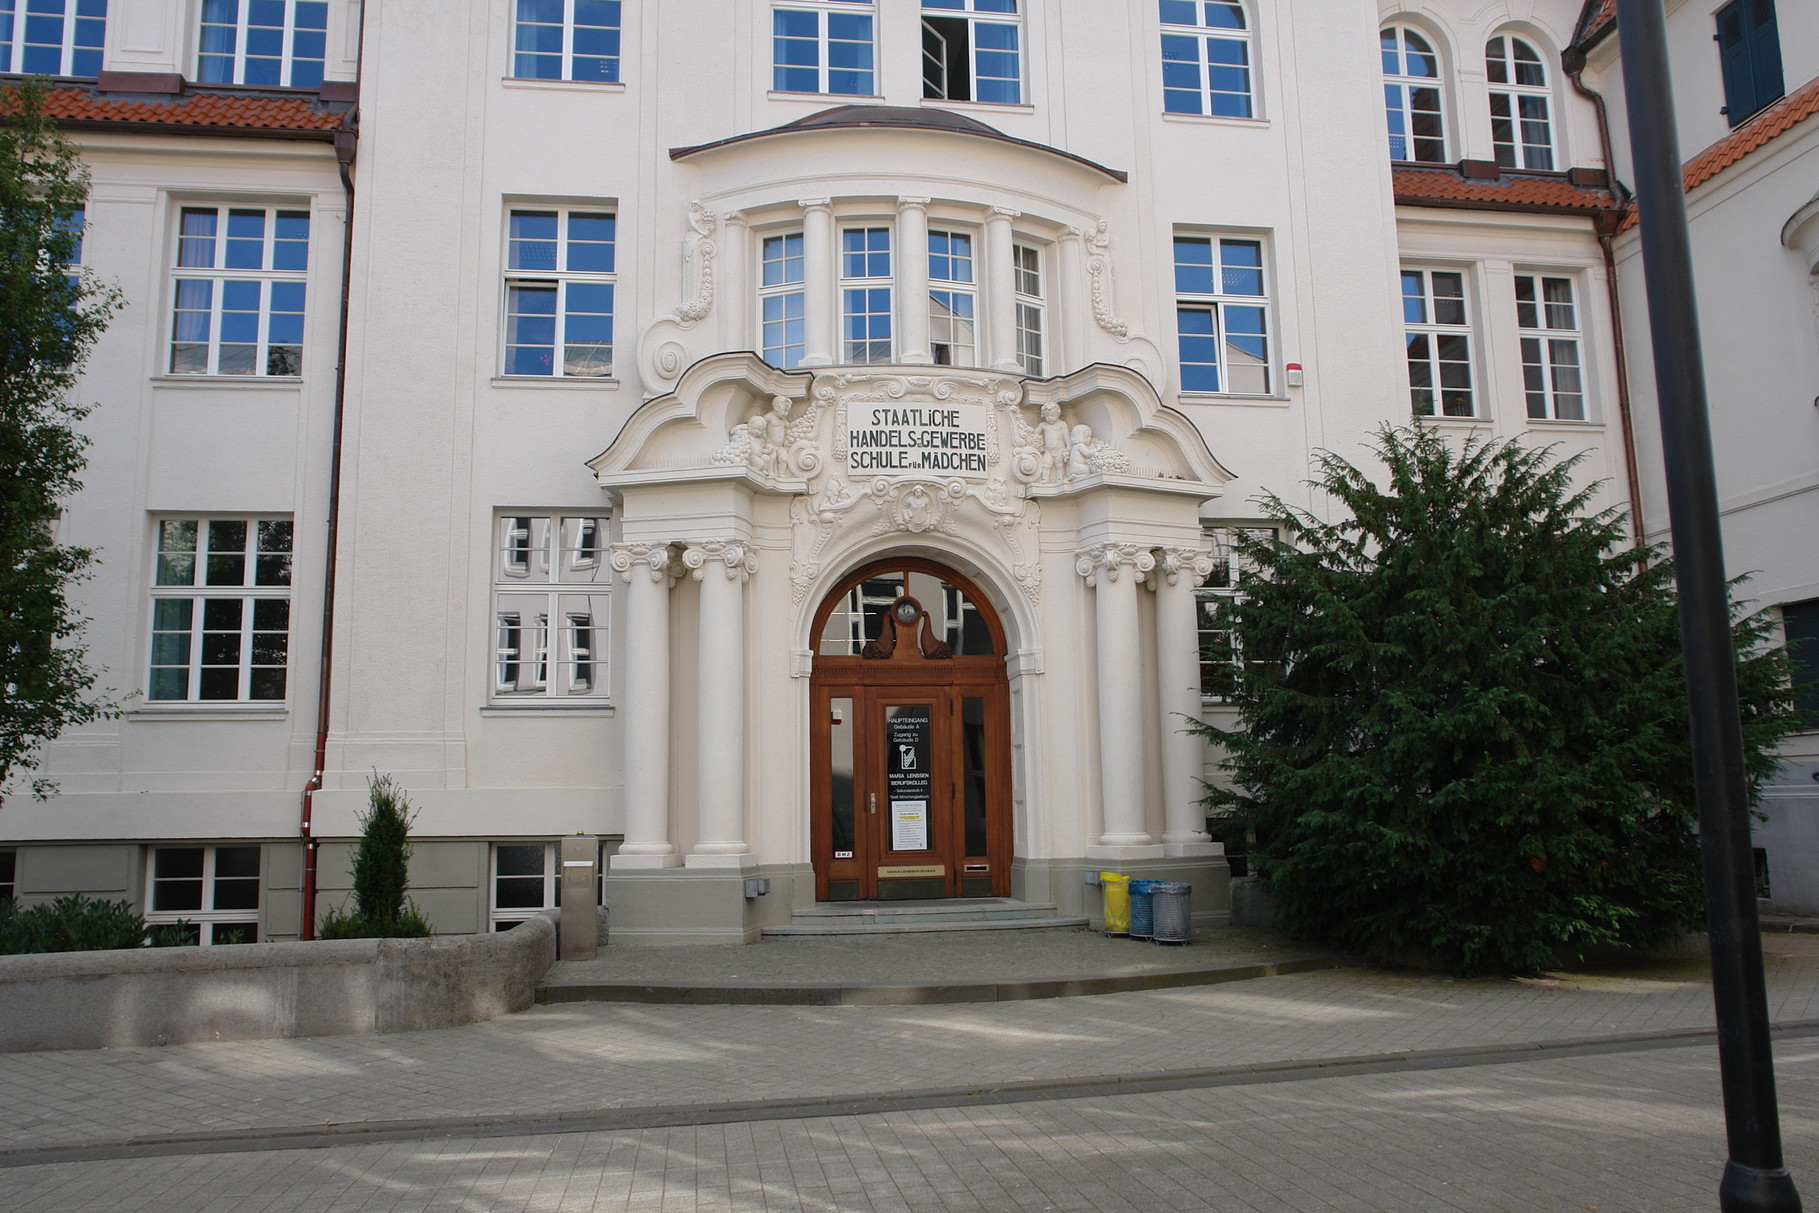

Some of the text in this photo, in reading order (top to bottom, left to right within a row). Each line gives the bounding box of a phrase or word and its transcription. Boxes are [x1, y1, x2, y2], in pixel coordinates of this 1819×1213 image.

[921, 430, 986, 451] GEWERBE
[850, 451, 986, 472] SCHULE FÜR MÄDCHEN
